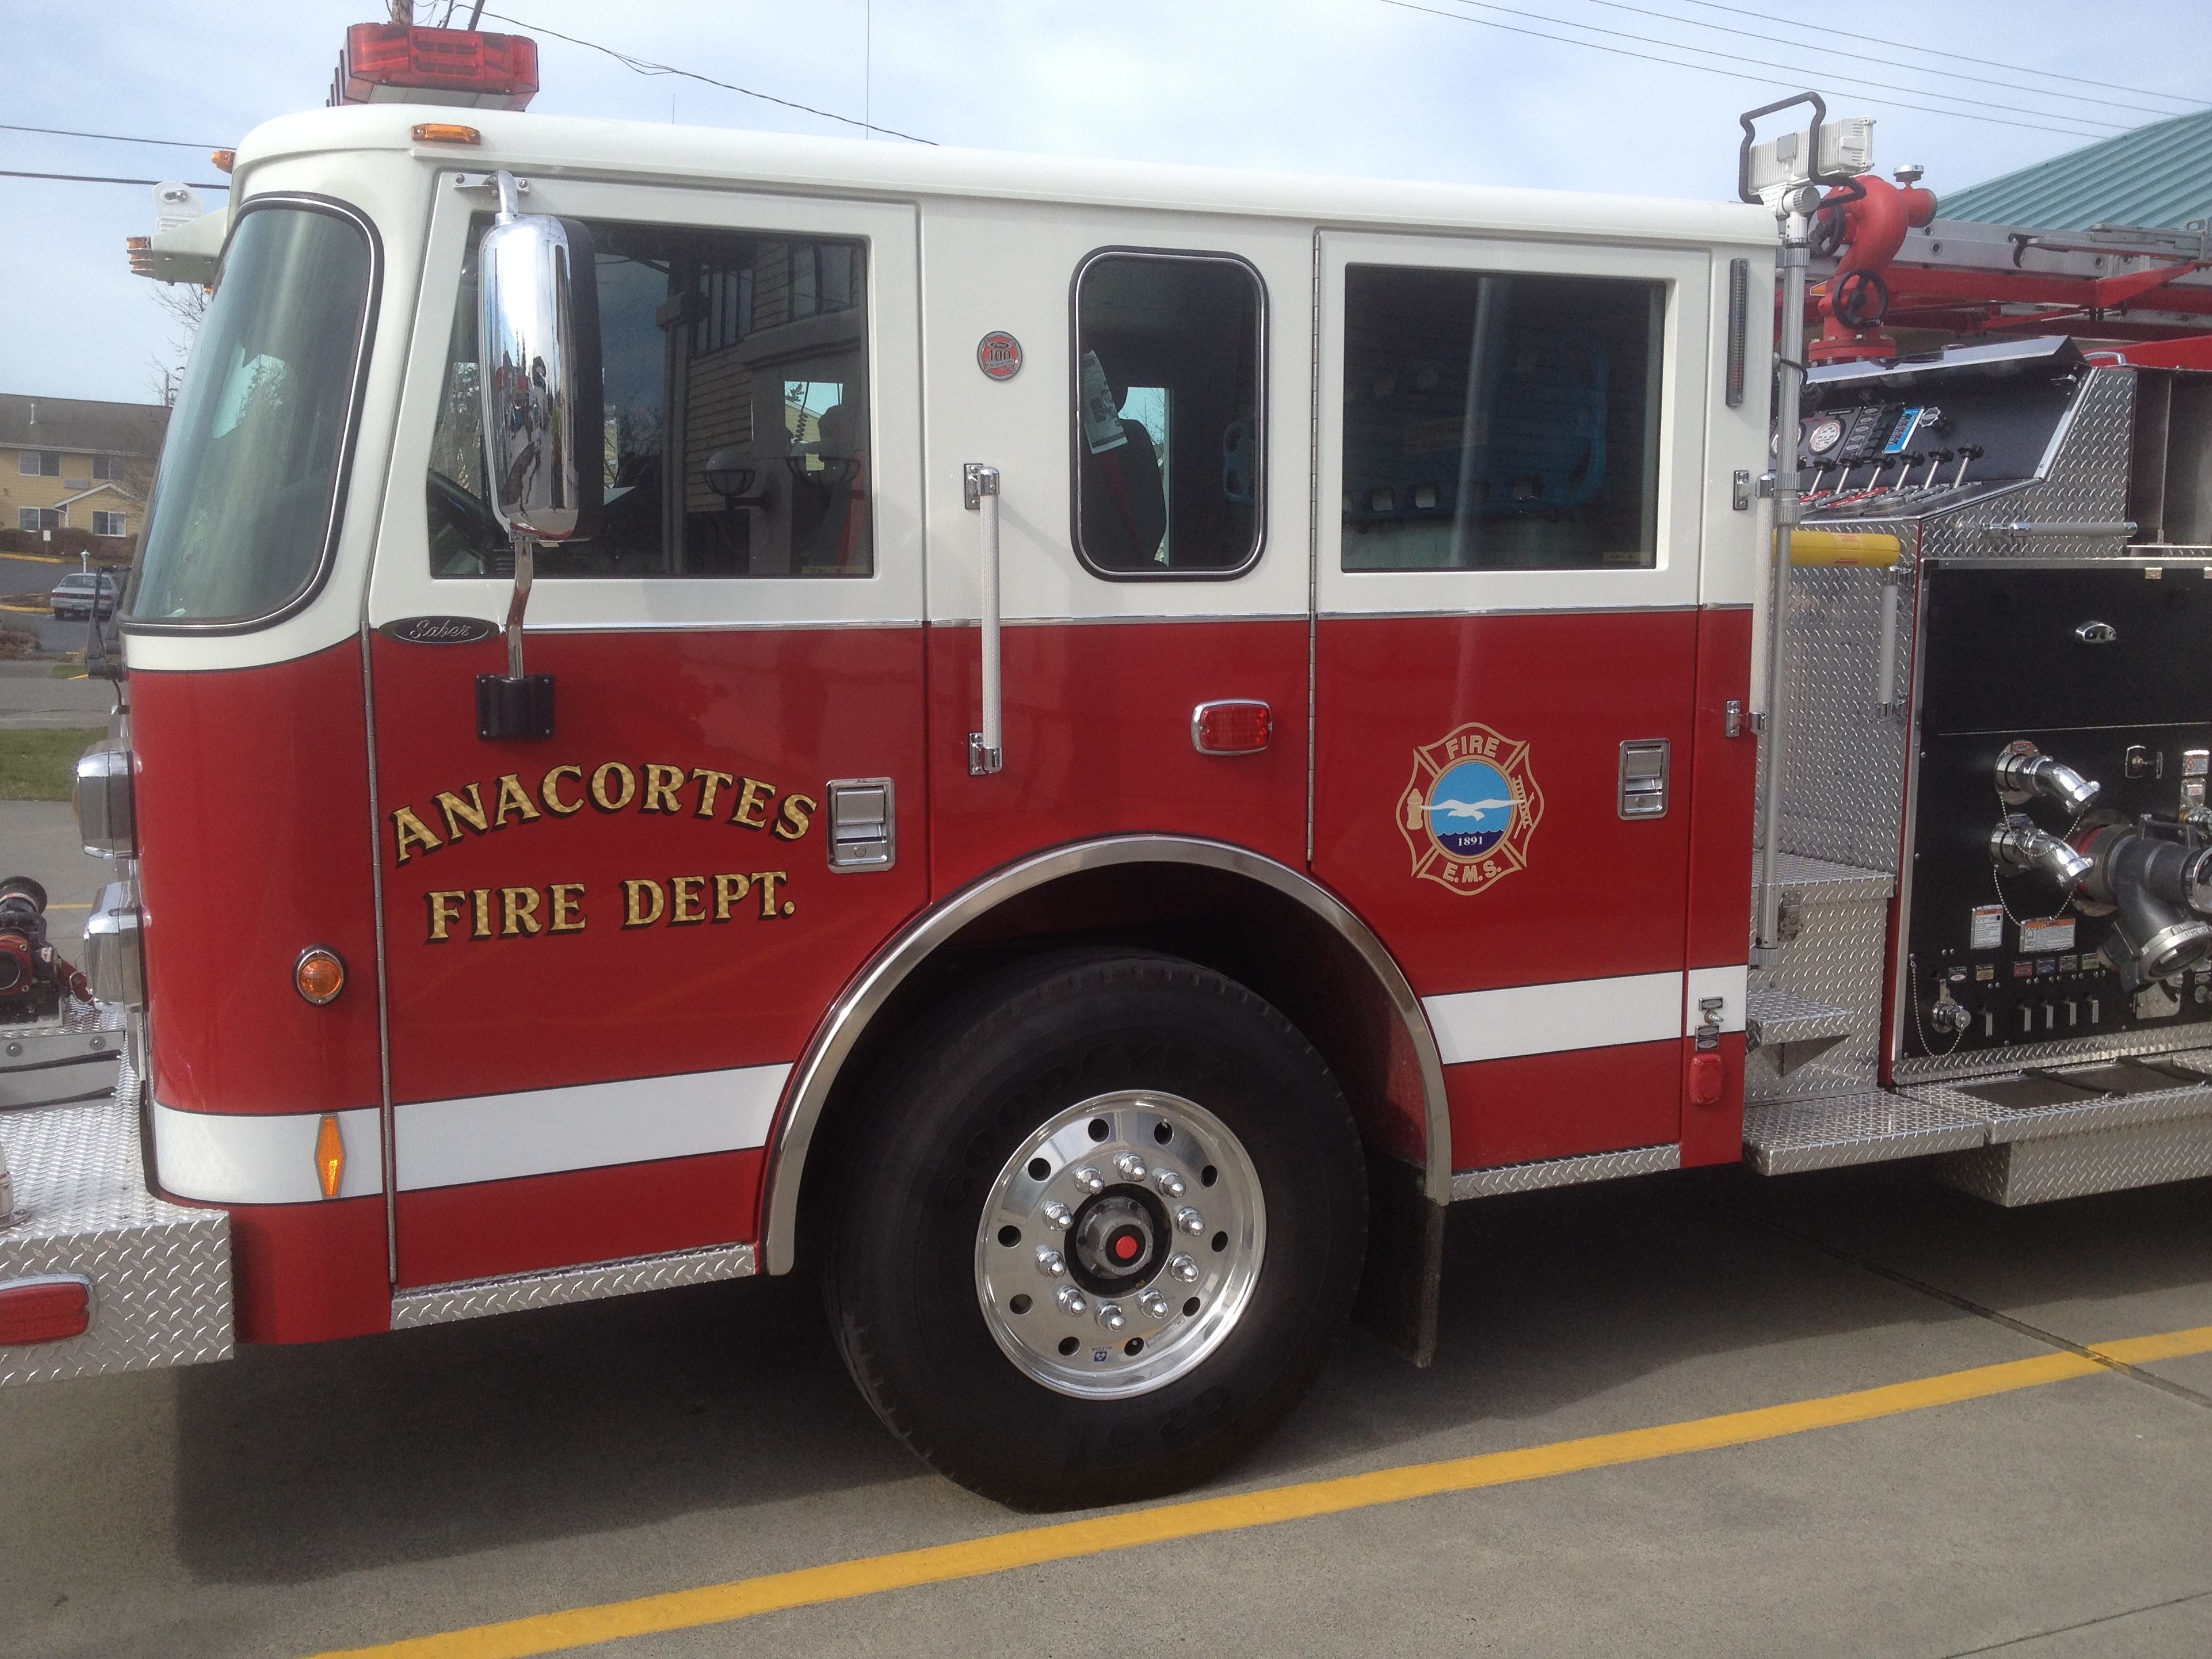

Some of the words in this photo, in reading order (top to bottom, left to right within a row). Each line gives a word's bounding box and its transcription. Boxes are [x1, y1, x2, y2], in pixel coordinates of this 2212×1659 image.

[409, 619, 471, 639] Saber
[1446, 735, 1500, 760] FIRE
[390, 760, 818, 869] ANACORTES
[1458, 836, 1483, 846] 1891
[1441, 860, 1502, 883] E.M.S.
[425, 882, 588, 943] FIRE
[621, 870, 797, 930] DEPT.
